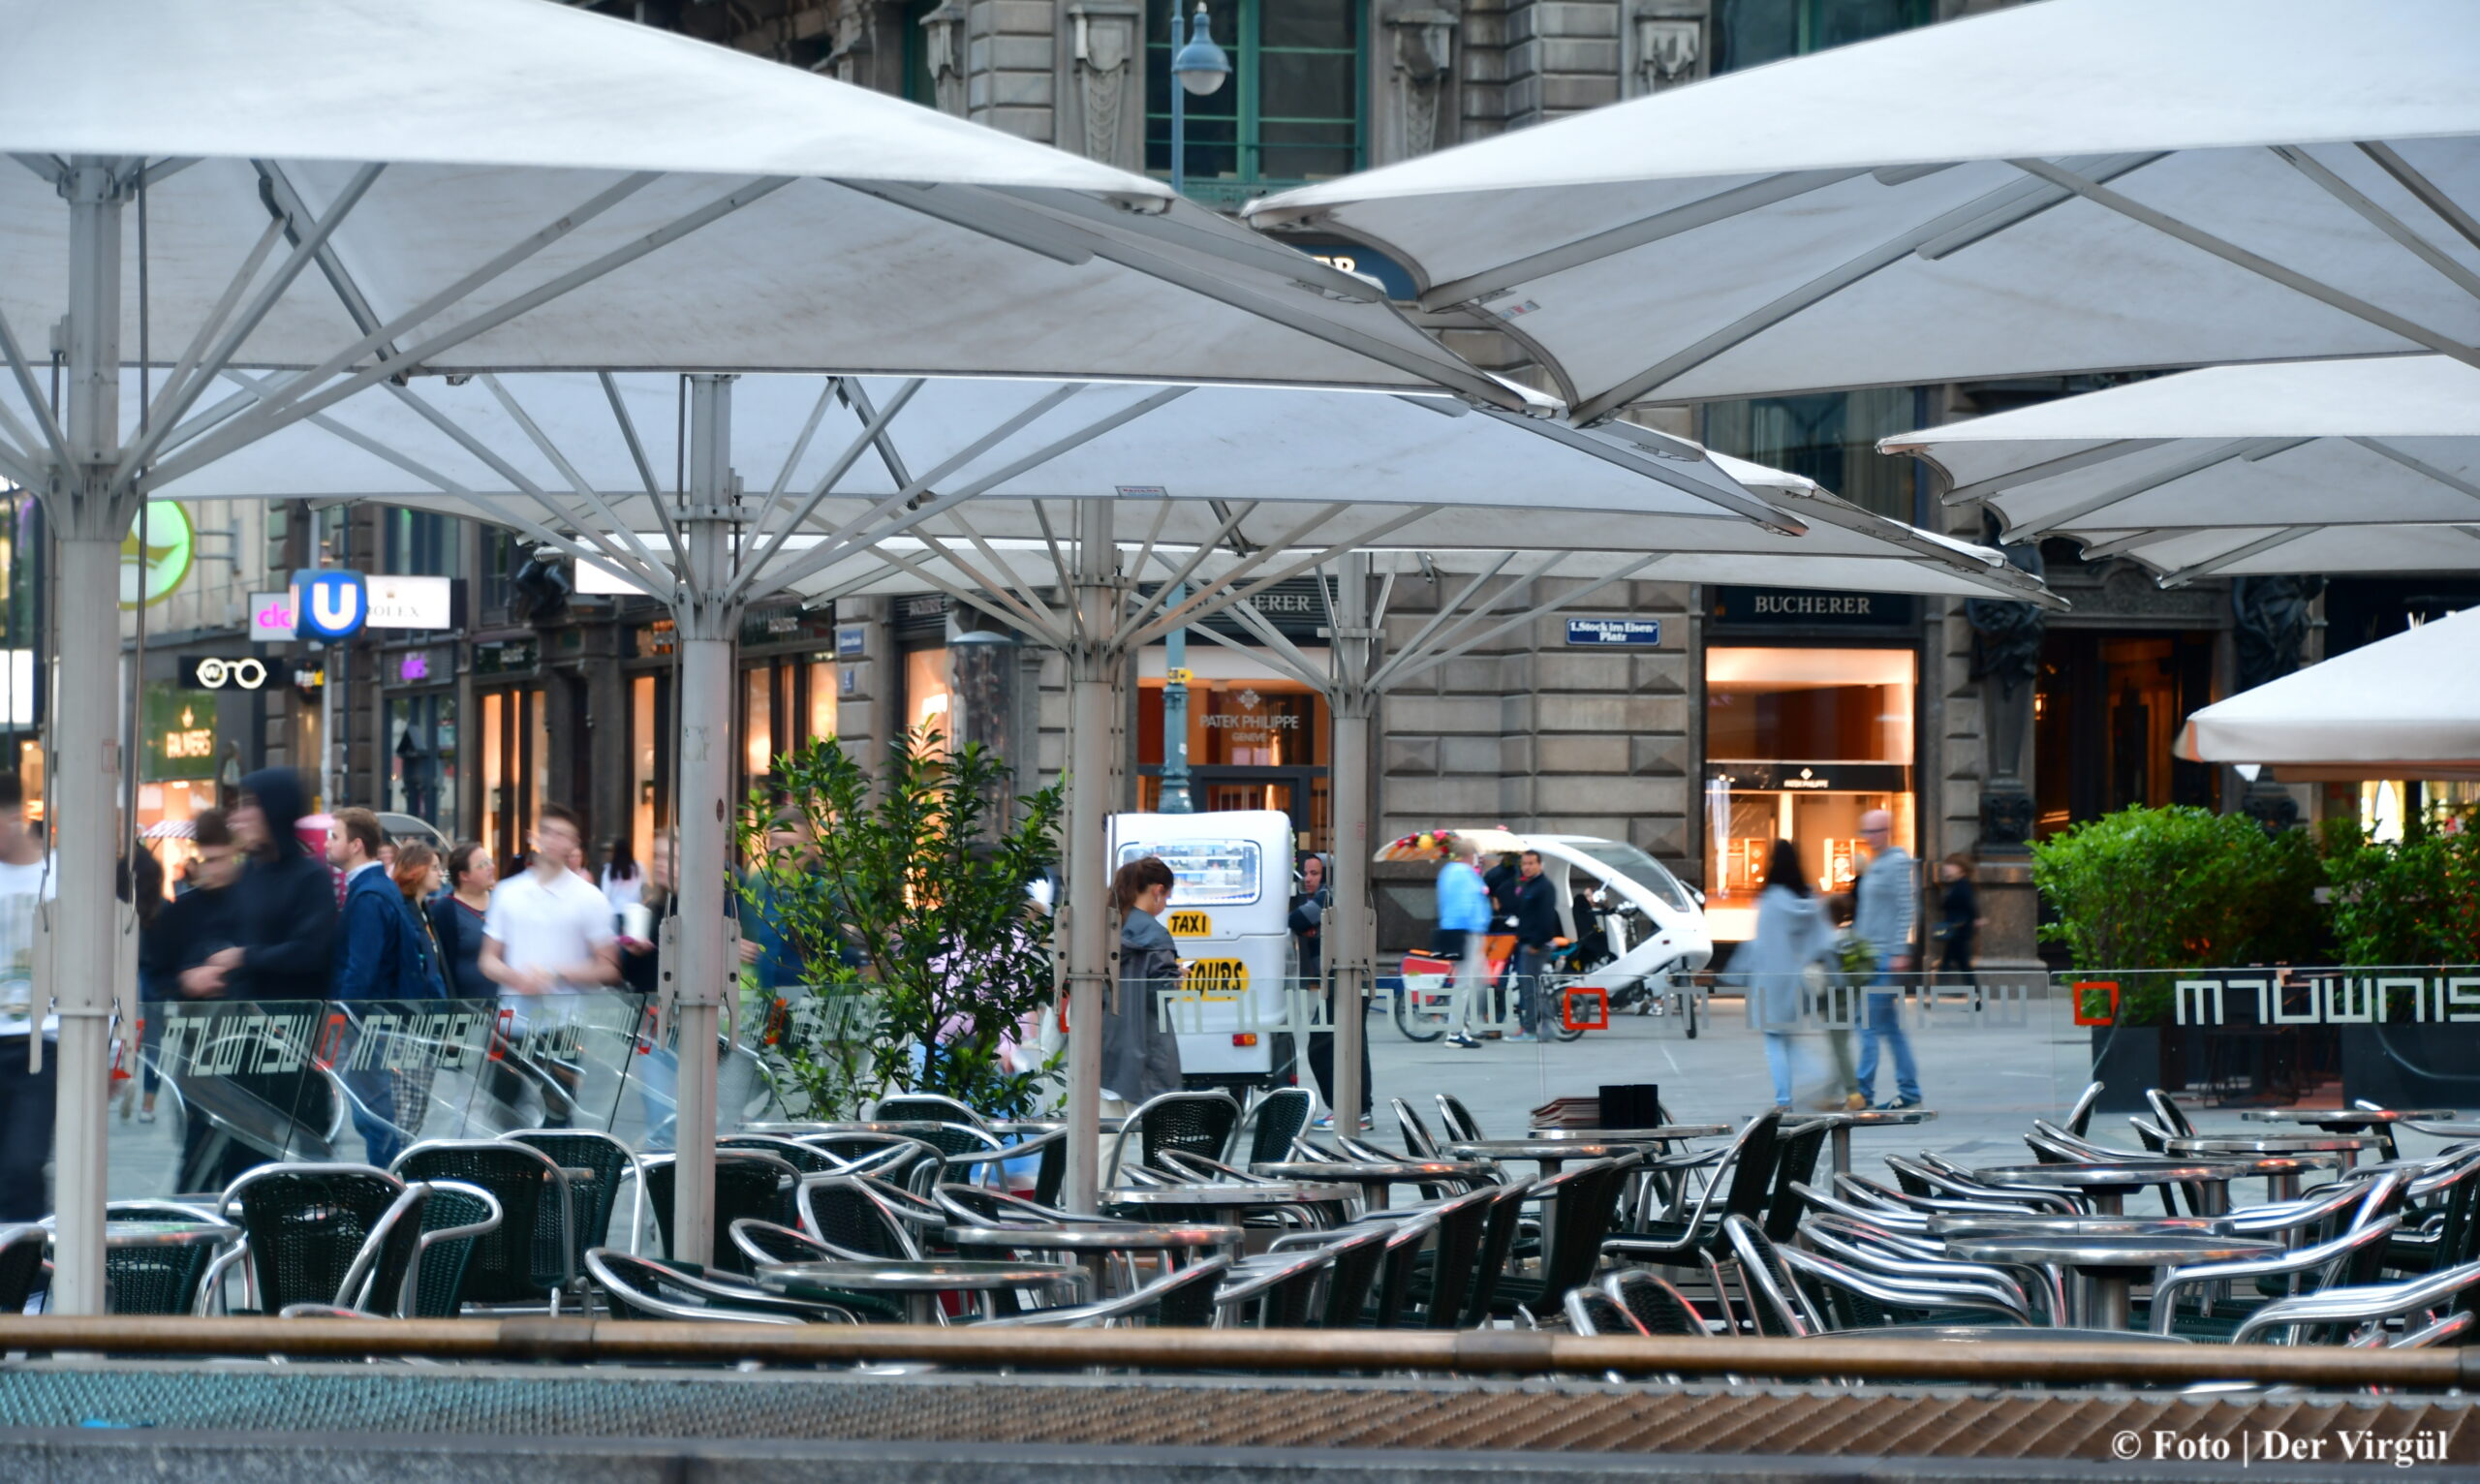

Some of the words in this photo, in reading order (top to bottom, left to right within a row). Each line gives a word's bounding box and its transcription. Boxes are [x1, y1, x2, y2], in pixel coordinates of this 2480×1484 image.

[313, 582, 357, 631] U
[1754, 596, 1872, 614] BUCHERER
[1199, 715, 1239, 728] PATEK
[1241, 715, 1300, 729] PHILIPPE
[1170, 914, 1207, 933] TAXI
